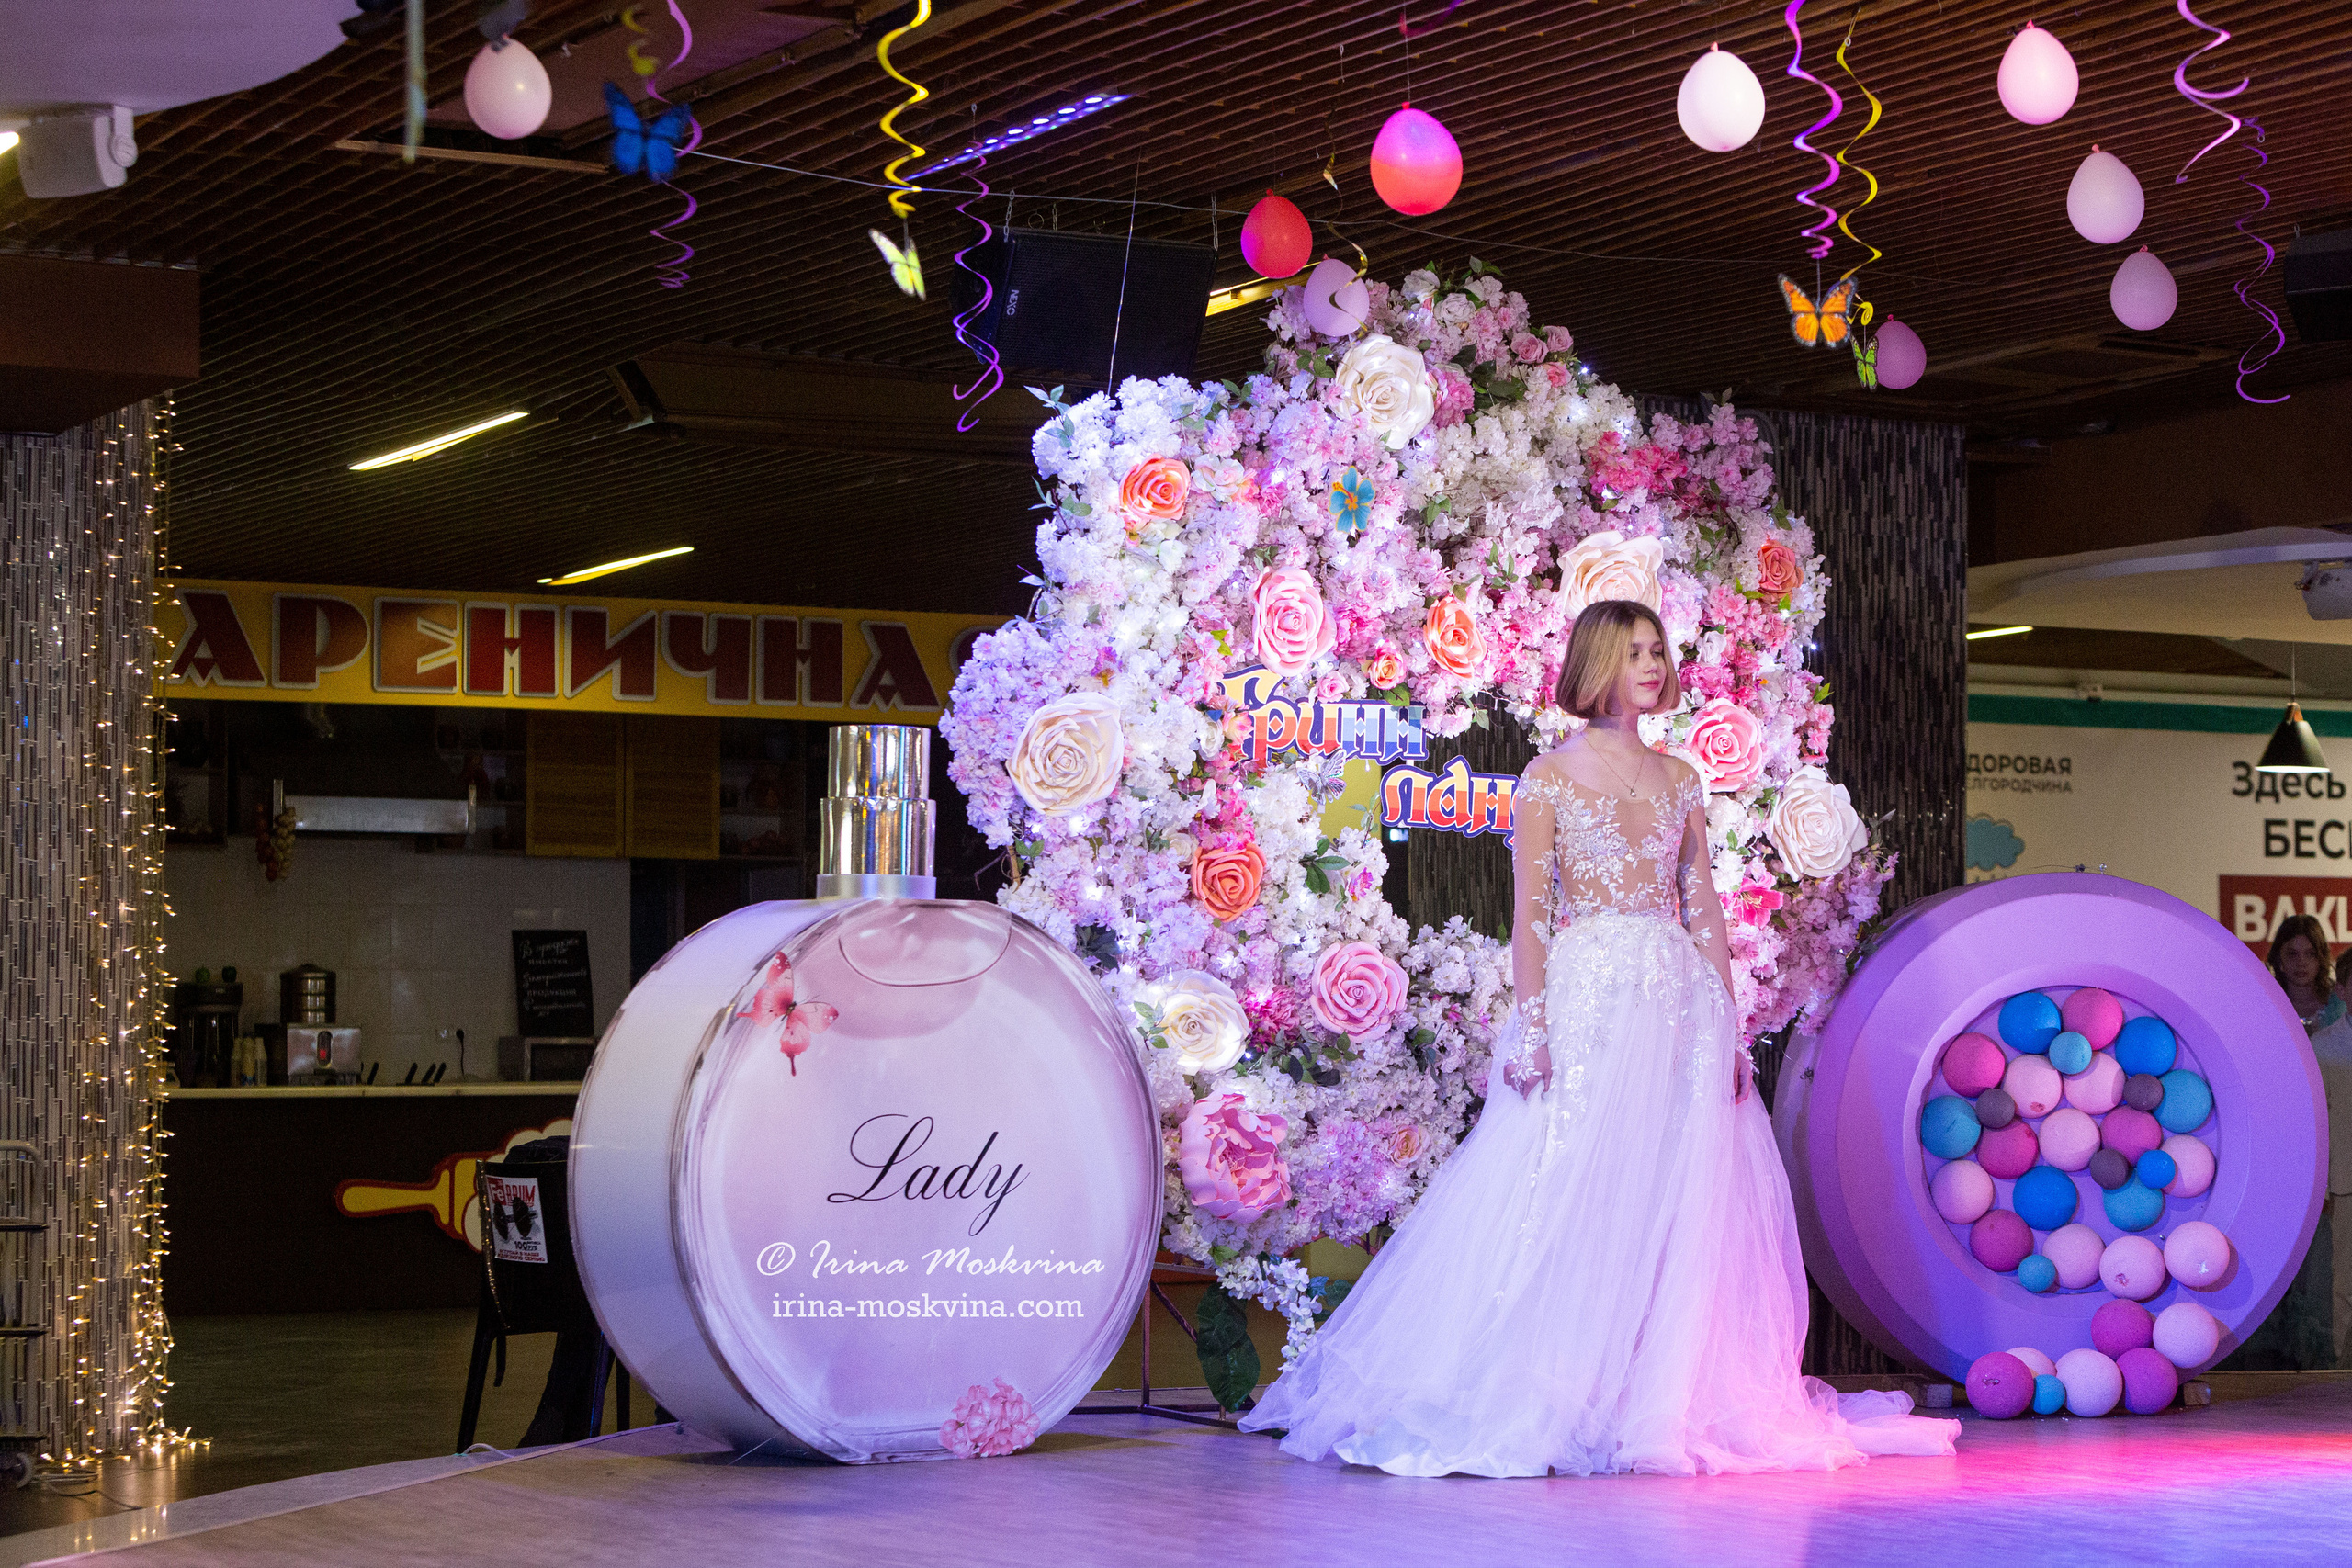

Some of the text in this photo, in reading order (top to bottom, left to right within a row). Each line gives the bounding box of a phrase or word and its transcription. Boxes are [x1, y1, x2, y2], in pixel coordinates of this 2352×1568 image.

[1006, 288, 1020, 316] NEXO
[2232, 760, 2347, 804] Здесь
[2264, 818, 2352, 860] БЕС
[827, 1113, 1031, 1236] Lady
[514, 1240, 528, 1250] 100
